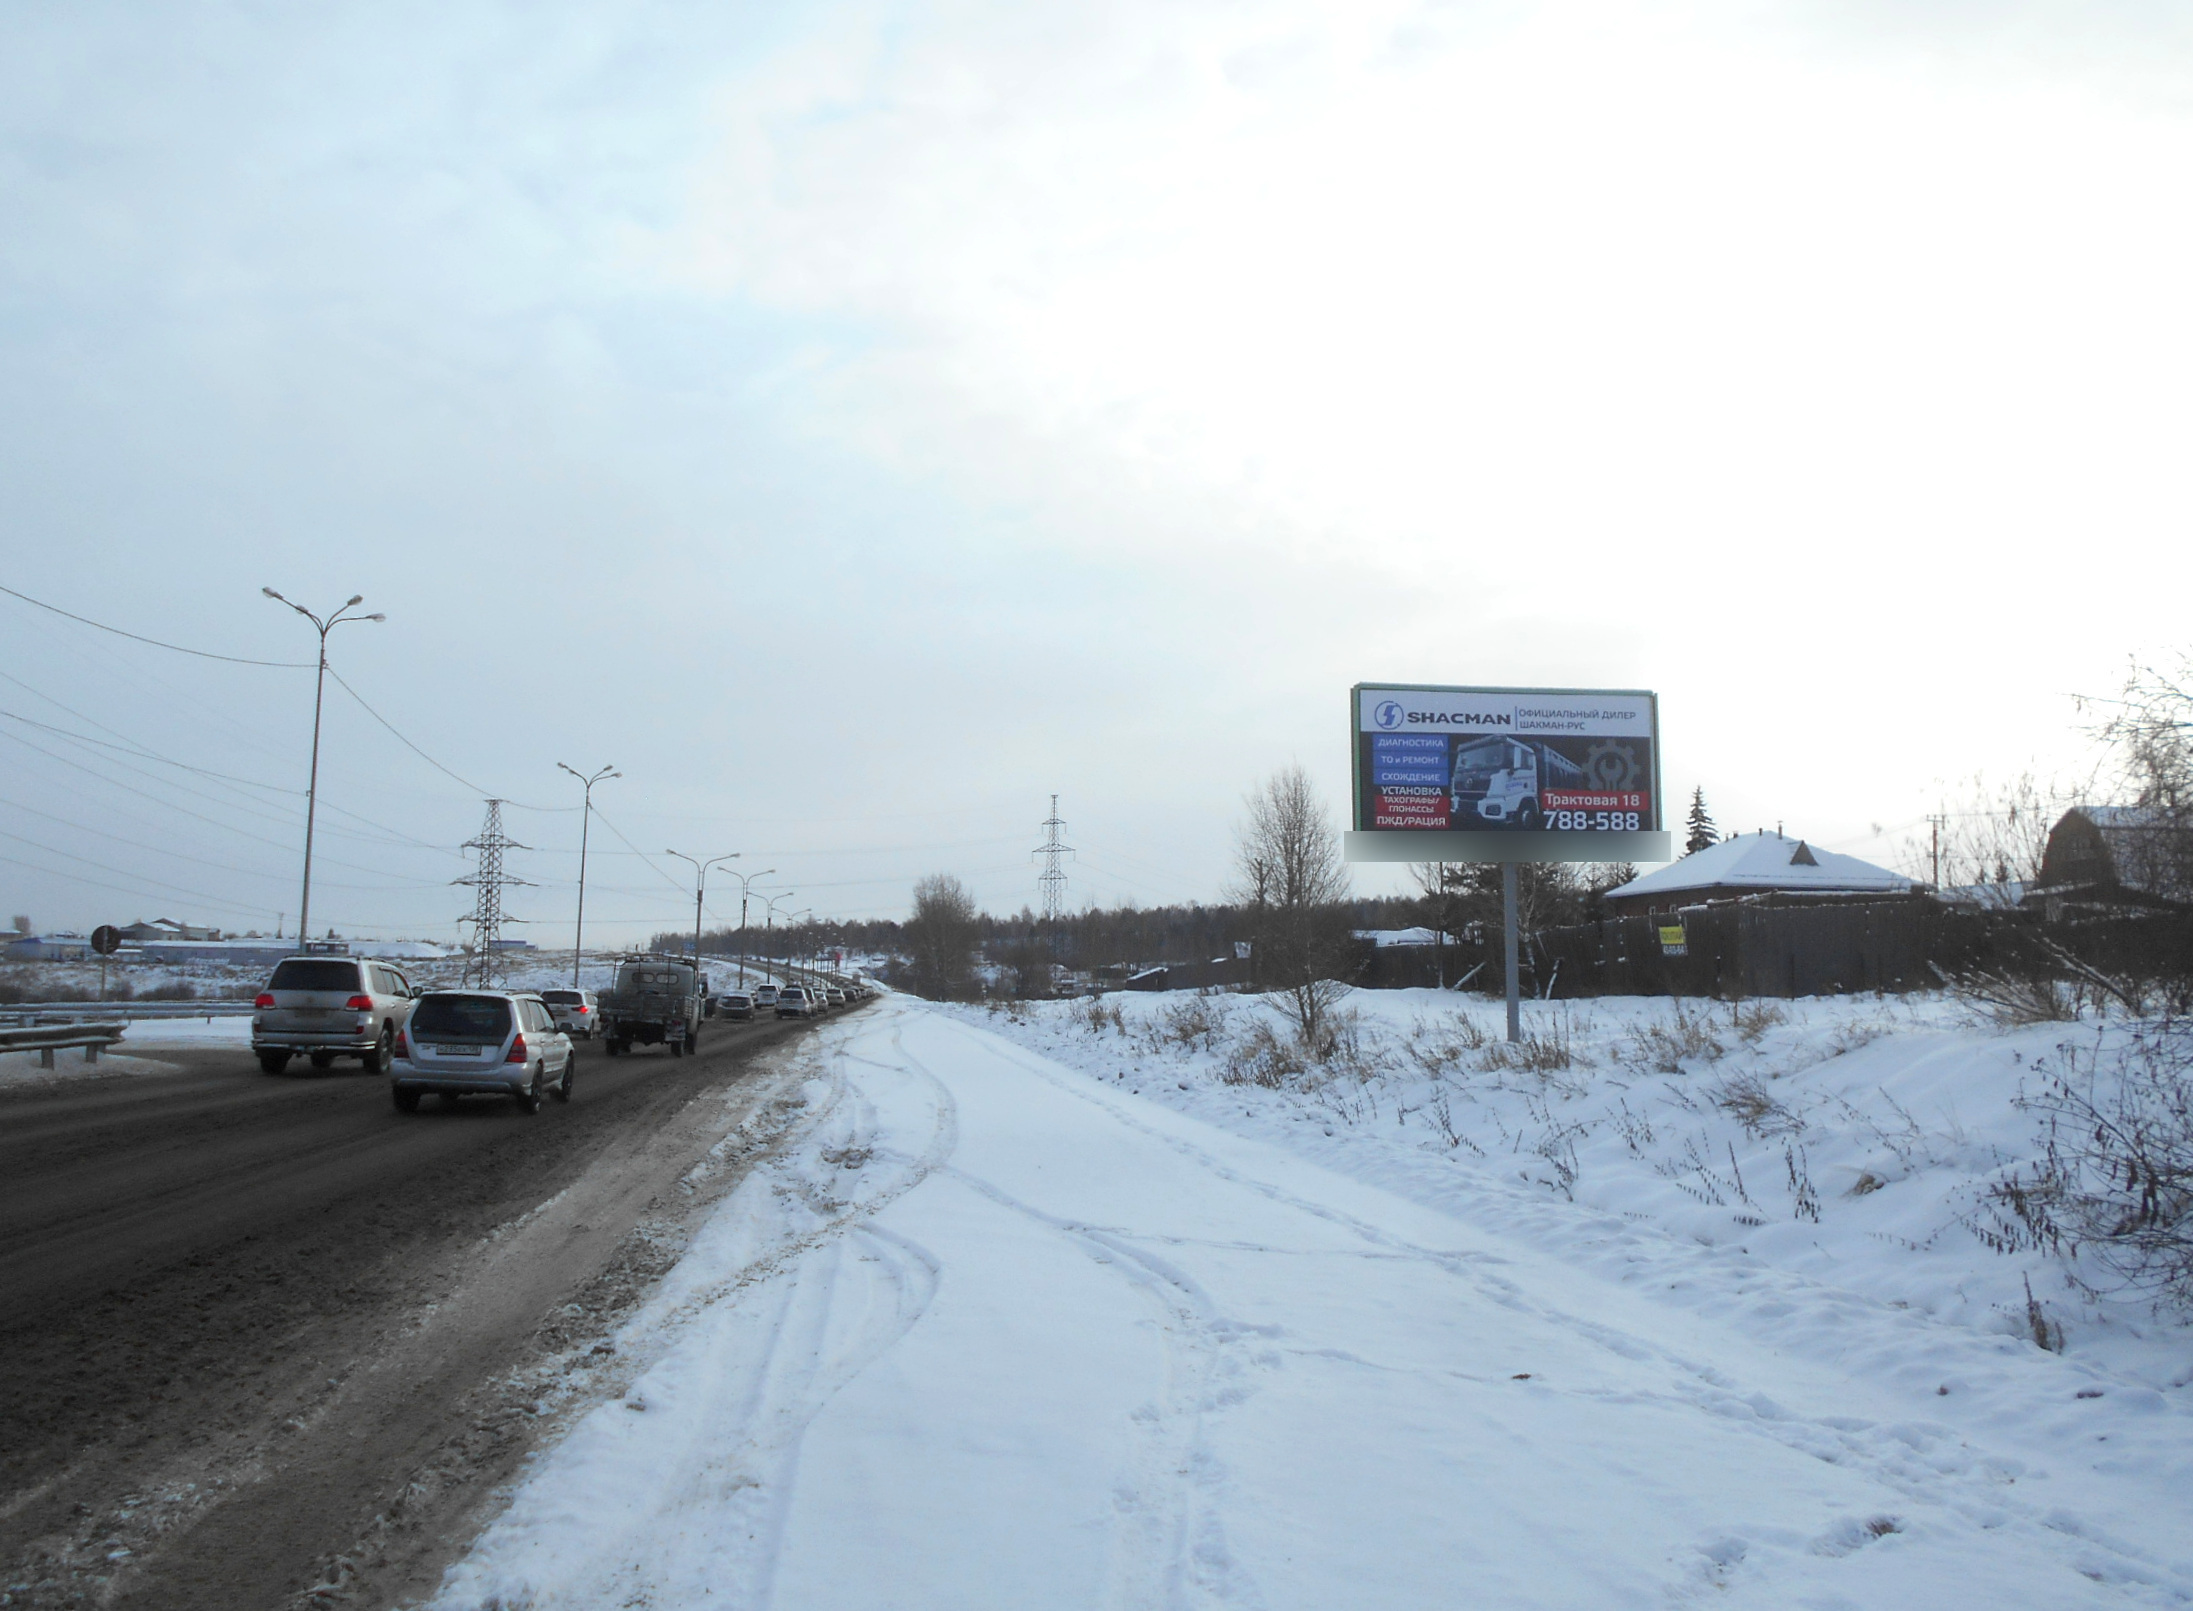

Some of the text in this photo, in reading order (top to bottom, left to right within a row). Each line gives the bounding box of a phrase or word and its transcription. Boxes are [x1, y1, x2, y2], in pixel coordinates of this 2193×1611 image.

[1407, 712, 1511, 725] SHACMAN
[1519, 708, 1636, 721] ОФИЦИАЛЬНЫЙ ДИЛЕР
[1519, 720, 1586, 731] ШАКМАН-РУС
[1378, 738, 1444, 747] ДИАГНОСТИКА
[1382, 756, 1394, 764] ТО
[1402, 756, 1440, 764] РЕМОНТ
[1381, 773, 1441, 782] СХОЖДЕНИЕ
[1381, 786, 1442, 796] УСТАНОВКА
[1383, 796, 1440, 804] ТАХОГРАФЫ/
[1545, 793, 1640, 808] Трактовая 18
[1389, 805, 1435, 813] ГЛОНАССЫ
[1376, 816, 1446, 827] ПЖД/РАЦИЯ
[1543, 810, 1640, 831] 788-588
